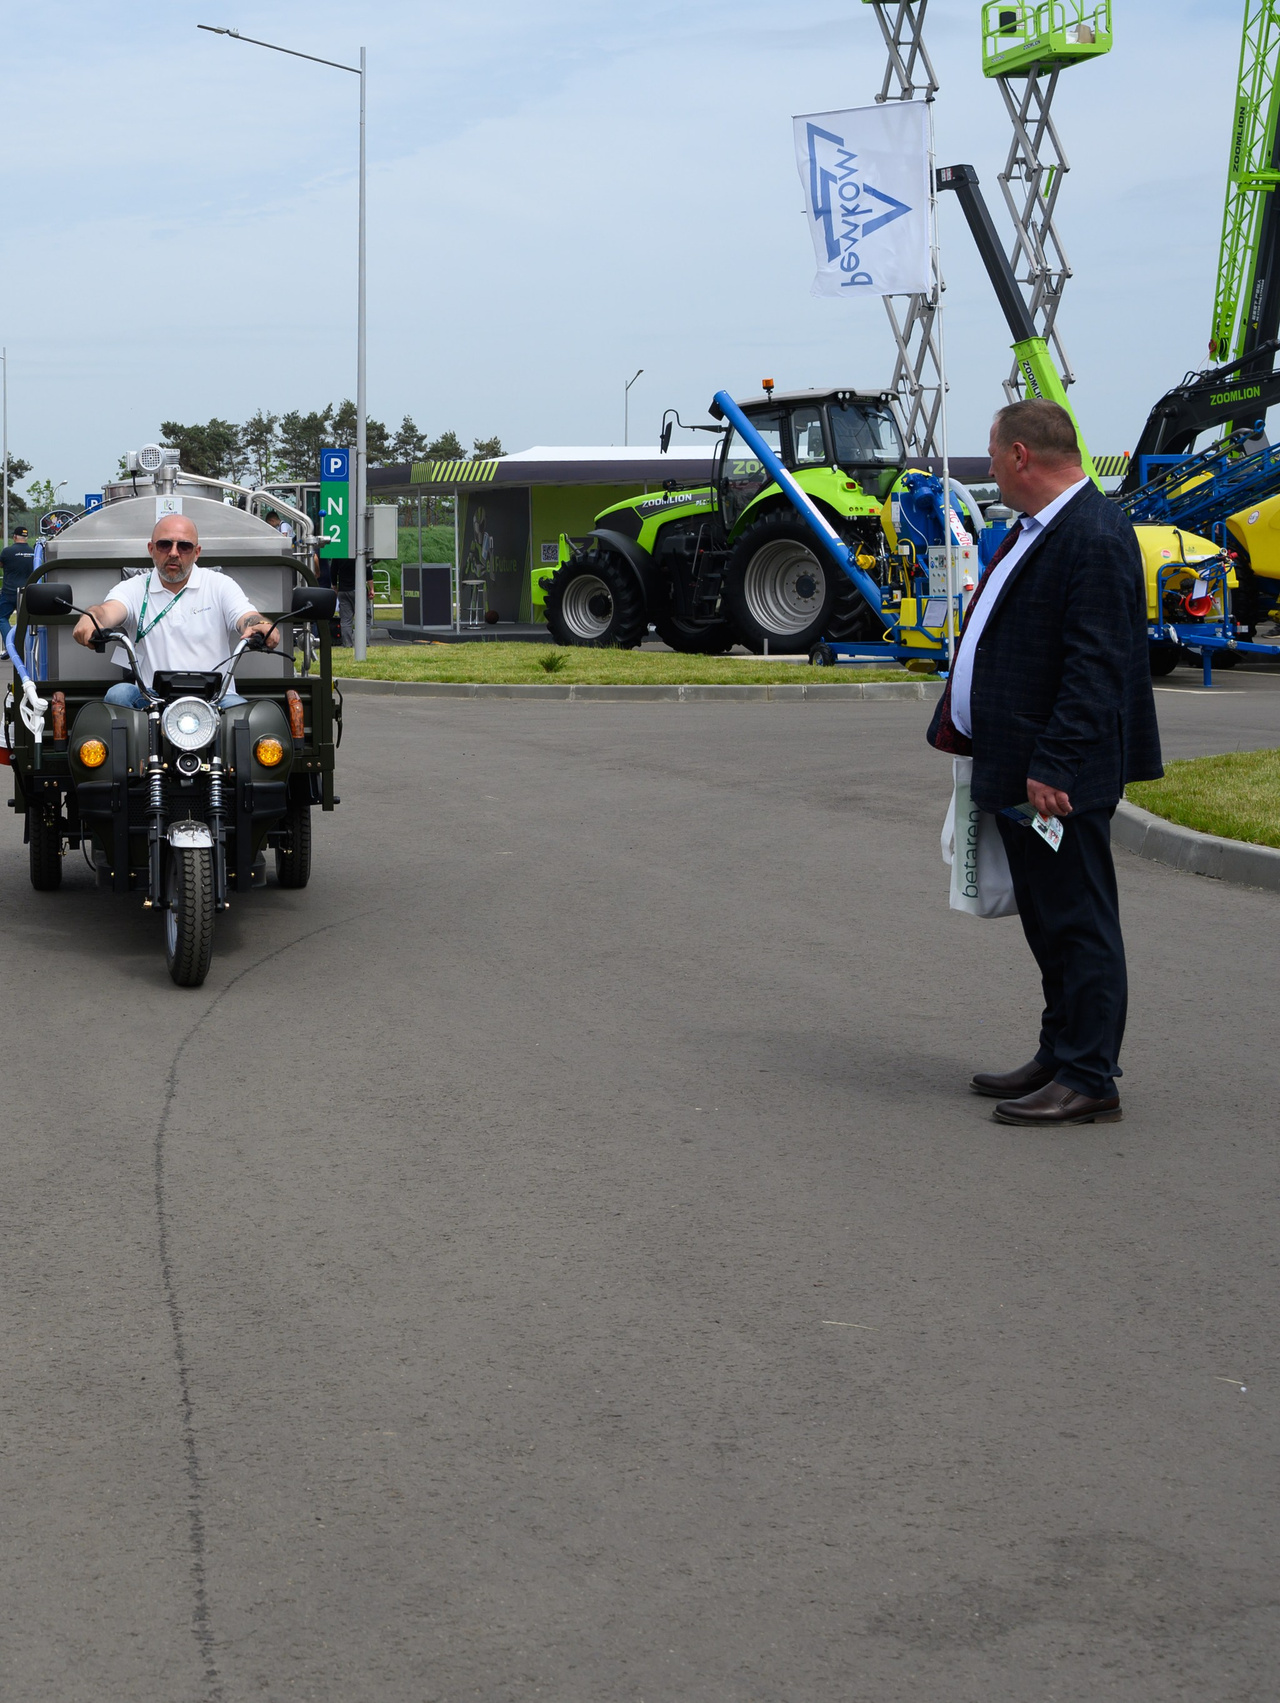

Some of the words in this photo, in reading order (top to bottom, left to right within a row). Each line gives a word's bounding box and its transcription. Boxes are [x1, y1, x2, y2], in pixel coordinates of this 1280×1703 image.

[1233, 106, 1246, 173] ZOOMLION
[1210, 385, 1261, 406] ZOOMLION
[330, 457, 342, 473] P
[327, 497, 343, 516] N
[328, 524, 341, 543] 2
[962, 810, 980, 898] betaren
